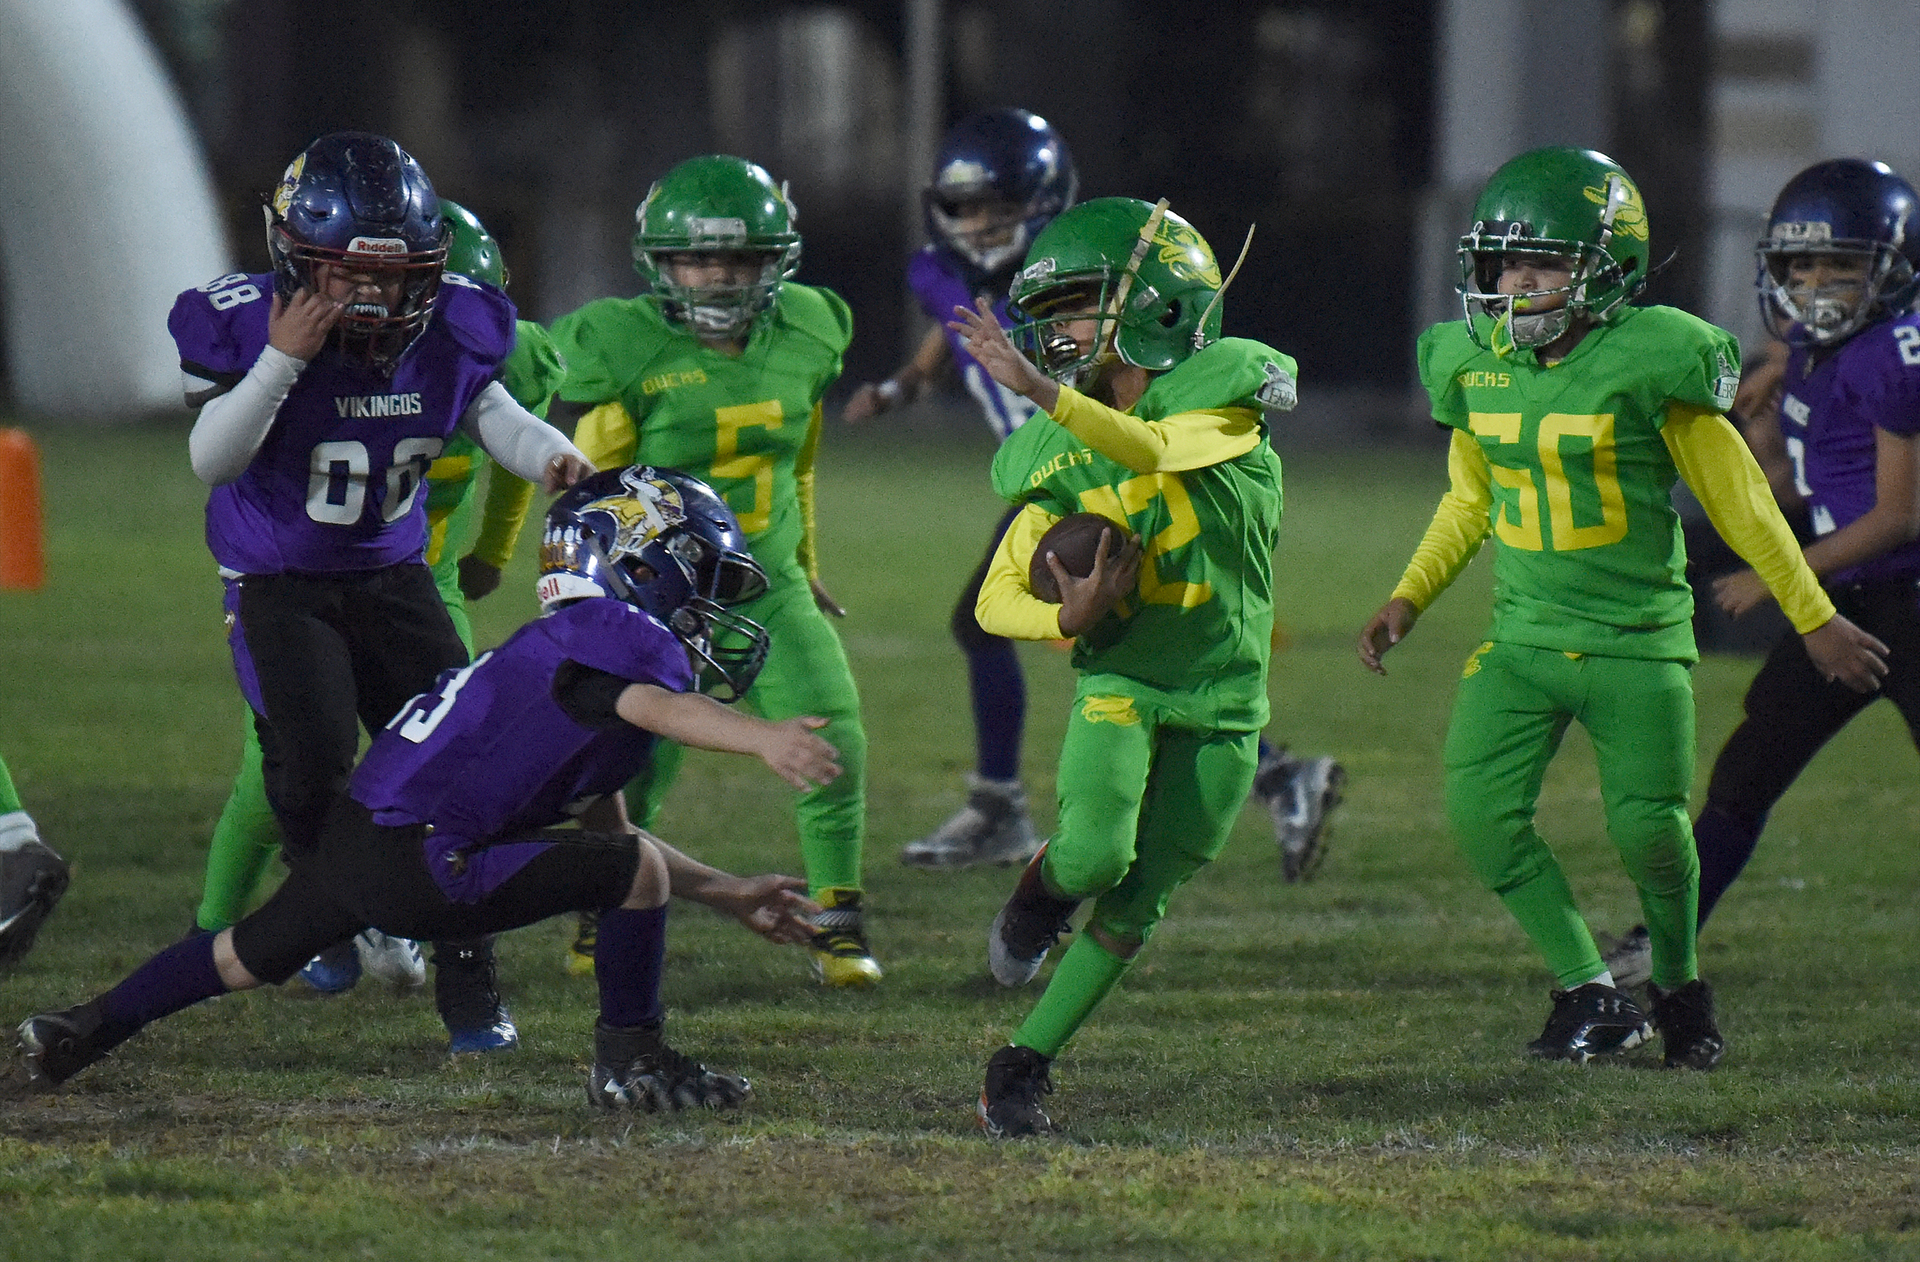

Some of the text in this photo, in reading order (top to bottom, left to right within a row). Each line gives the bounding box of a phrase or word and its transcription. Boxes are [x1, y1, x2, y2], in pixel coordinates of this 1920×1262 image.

[357, 240, 405, 253] Riddell
[196, 272, 262, 311] 88
[334, 392, 423, 418] VIKINGOS
[710, 399, 783, 533] 5
[1030, 448, 1094, 488] DUCKS
[1468, 411, 1628, 552] 50
